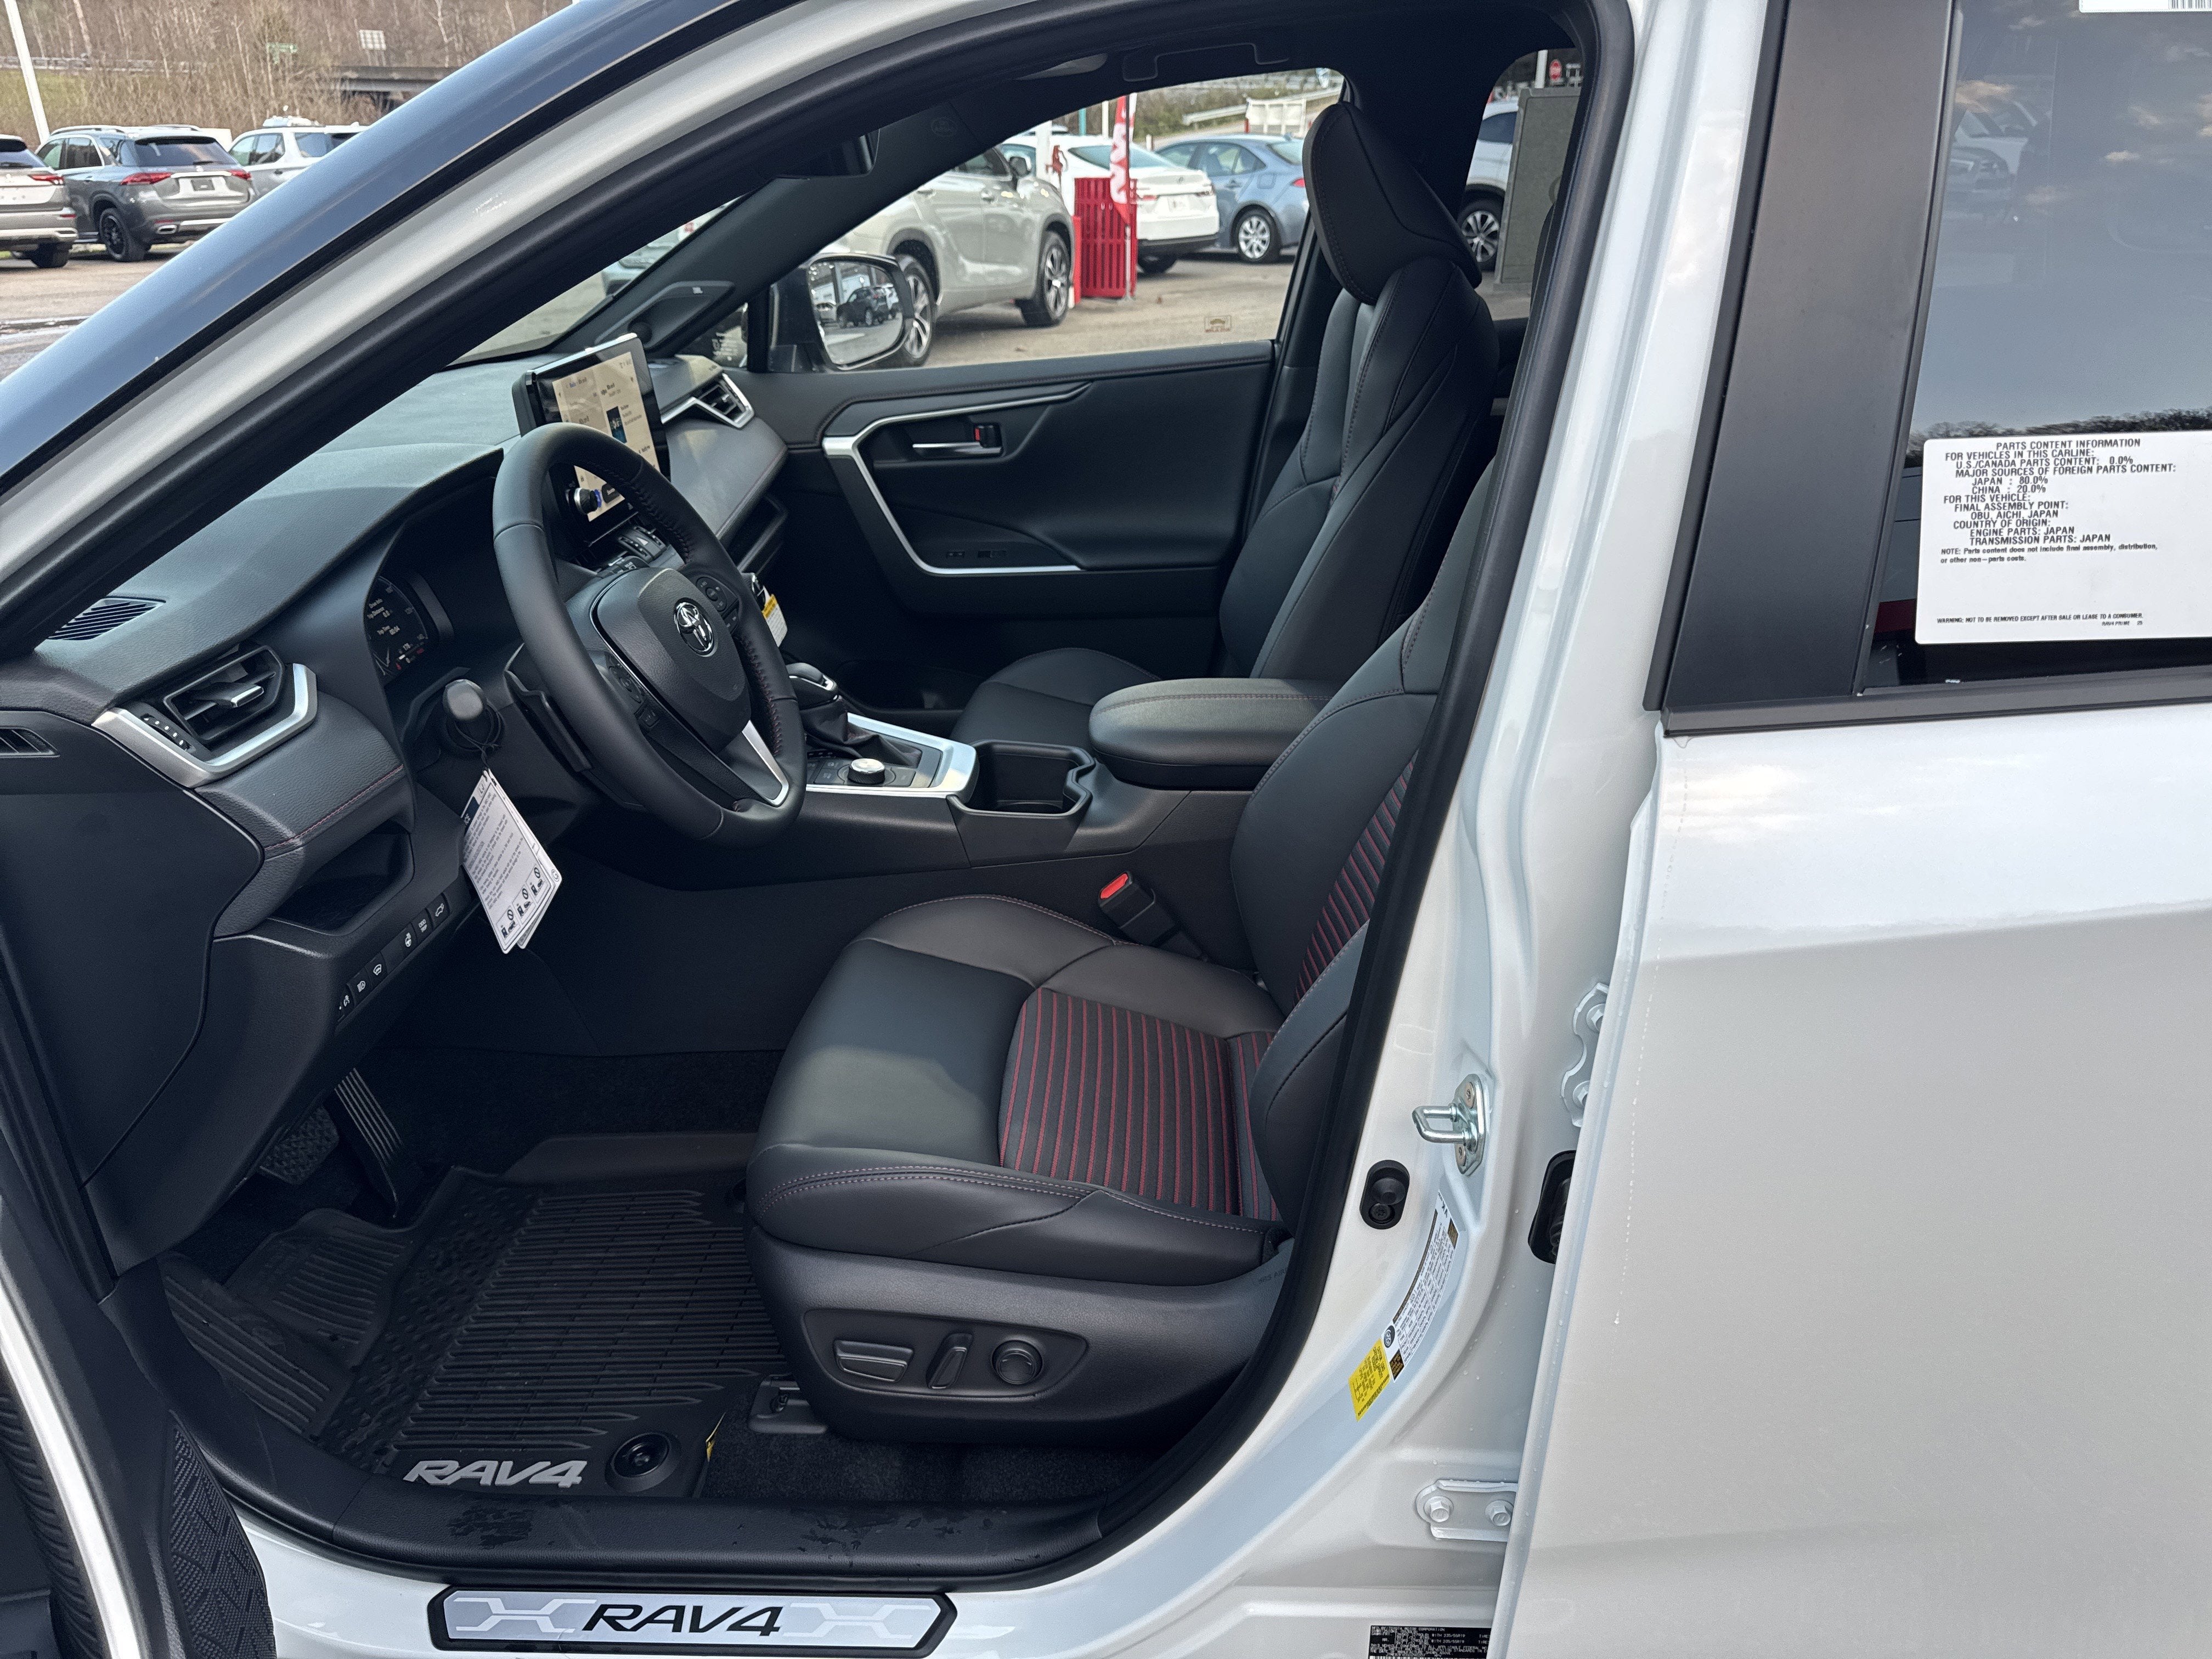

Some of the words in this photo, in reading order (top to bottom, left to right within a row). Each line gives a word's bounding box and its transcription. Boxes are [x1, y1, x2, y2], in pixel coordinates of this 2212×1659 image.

[1996, 442, 2026, 450] PARTS
[2030, 441, 2072, 449] CONTENT
[2076, 438, 2140, 448] INFORMATION
[1945, 453, 1963, 461] FOR
[1967, 451, 2010, 460] VEHICLES
[2014, 450, 2023, 459] IN
[2027, 450, 2048, 458] THIS
[2052, 448, 2094, 458] CARLINE:
[2020, 458, 2050, 467] PARTS
[2053, 456, 2100, 466] CONTENT:
[2109, 455, 2133, 465] 0.0%
[1955, 469, 1988, 478] MAJOR
[1991, 467, 2034, 477] SOURCES
[2038, 467, 2050, 476] OF
[2053, 465, 2094, 475] FOREIGN
[2096, 465, 2127, 473] PARTS
[2130, 463, 2176, 472] CONTENT:
[1972, 477, 2002, 486] JAPAN
[2019, 476, 2048, 484] 80.0%
[1972, 486, 2000, 494] CHINA
[2017, 485, 2046, 493] 20.0%
[1943, 495, 1961, 504] FOR
[1965, 494, 1985, 503] THIS
[1989, 493, 2030, 502] VEHICLE:
[1954, 504, 1981, 512] FINAL
[1984, 502, 2034, 511] ASSEMBLY
[2038, 501, 2069, 509] POINT:
[1971, 511, 1993, 521] OBU,
[1996, 511, 2024, 520] AICHI,
[2028, 510, 2058, 518] JAPAN
[1953, 520, 1997, 529] COUNTRY
[2000, 519, 2013, 528] OF
[2016, 518, 2051, 527] ORIGIN:
[1970, 528, 2004, 537] ENGINE
[2007, 527, 2041, 536] PARTS:
[2044, 526, 2074, 535] JAPAN
[1970, 536, 2040, 546] TRANSMISSION
[2043, 534, 2077, 544] PARTS:
[2080, 534, 2111, 543] JAPAN
[403, 1460, 588, 1488] RAV4
[582, 1604, 783, 1637] RAV4
